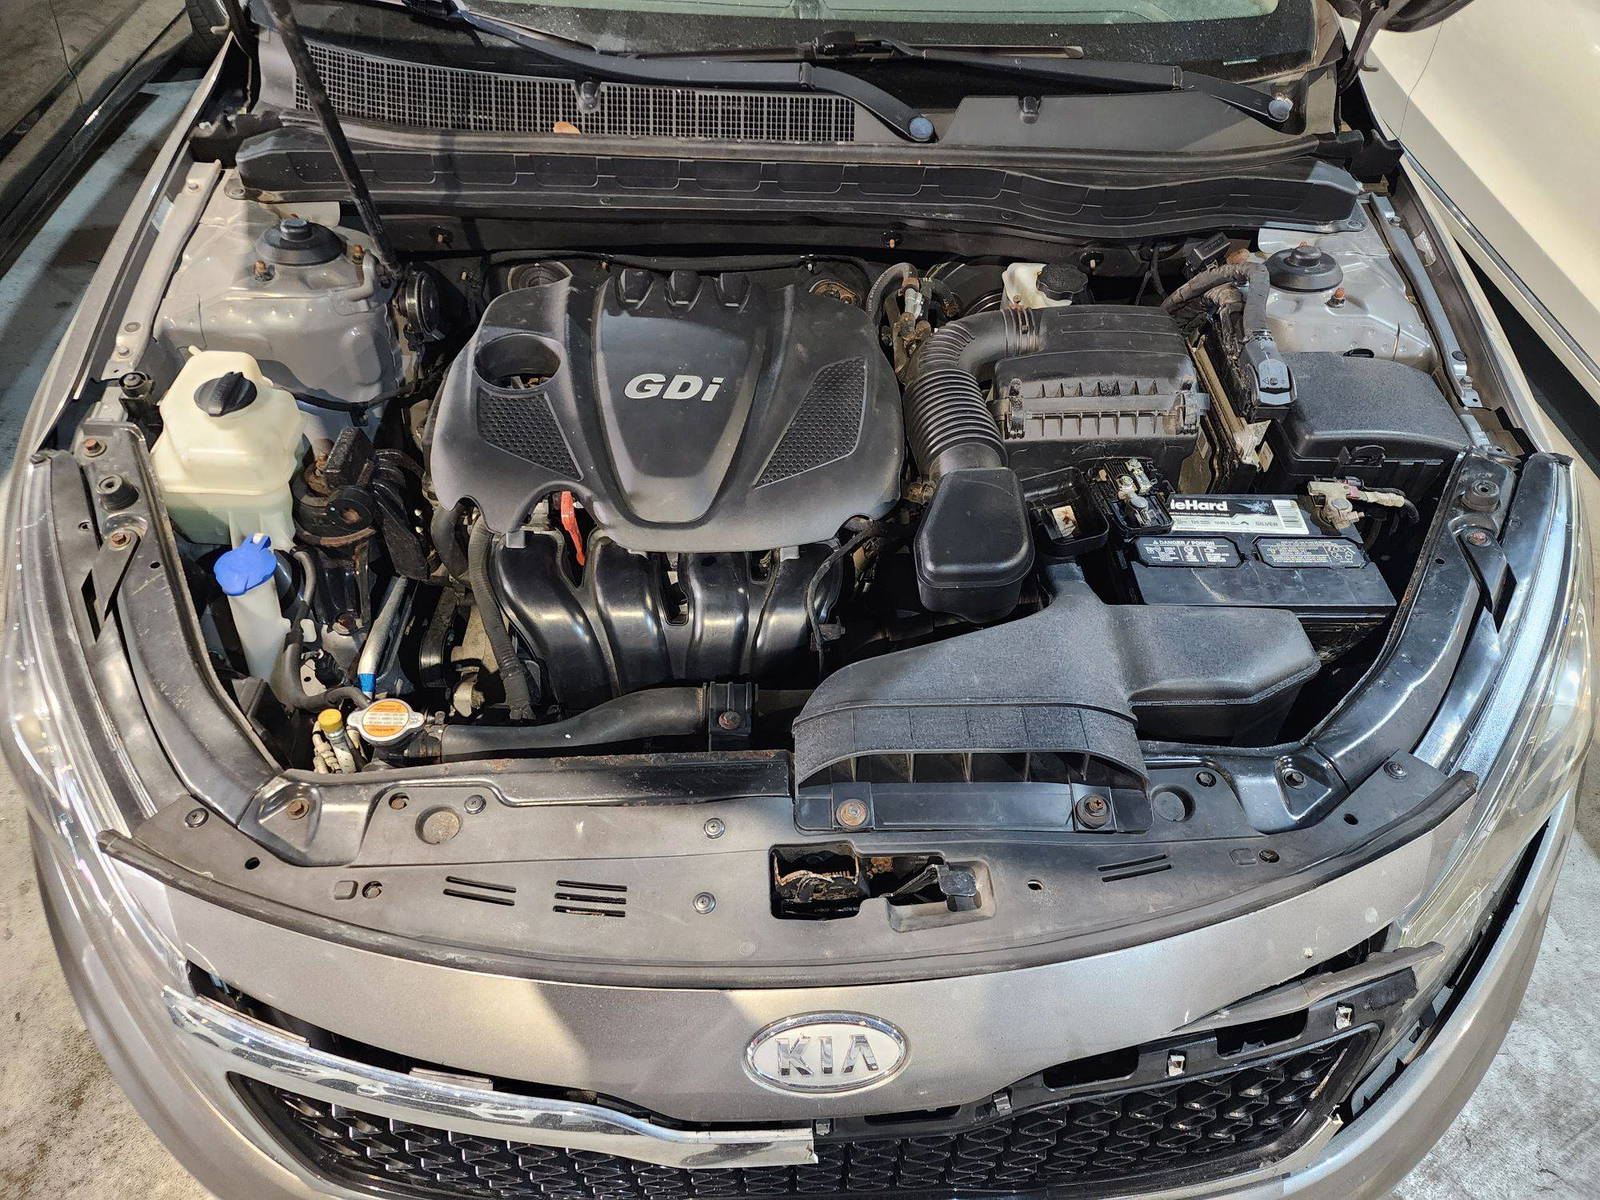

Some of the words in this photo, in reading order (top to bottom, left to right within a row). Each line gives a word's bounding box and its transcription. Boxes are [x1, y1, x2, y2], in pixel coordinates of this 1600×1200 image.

[624, 373, 724, 401] GDi
[1170, 499, 1229, 511] ieHard
[775, 1033, 879, 1076] KIA
